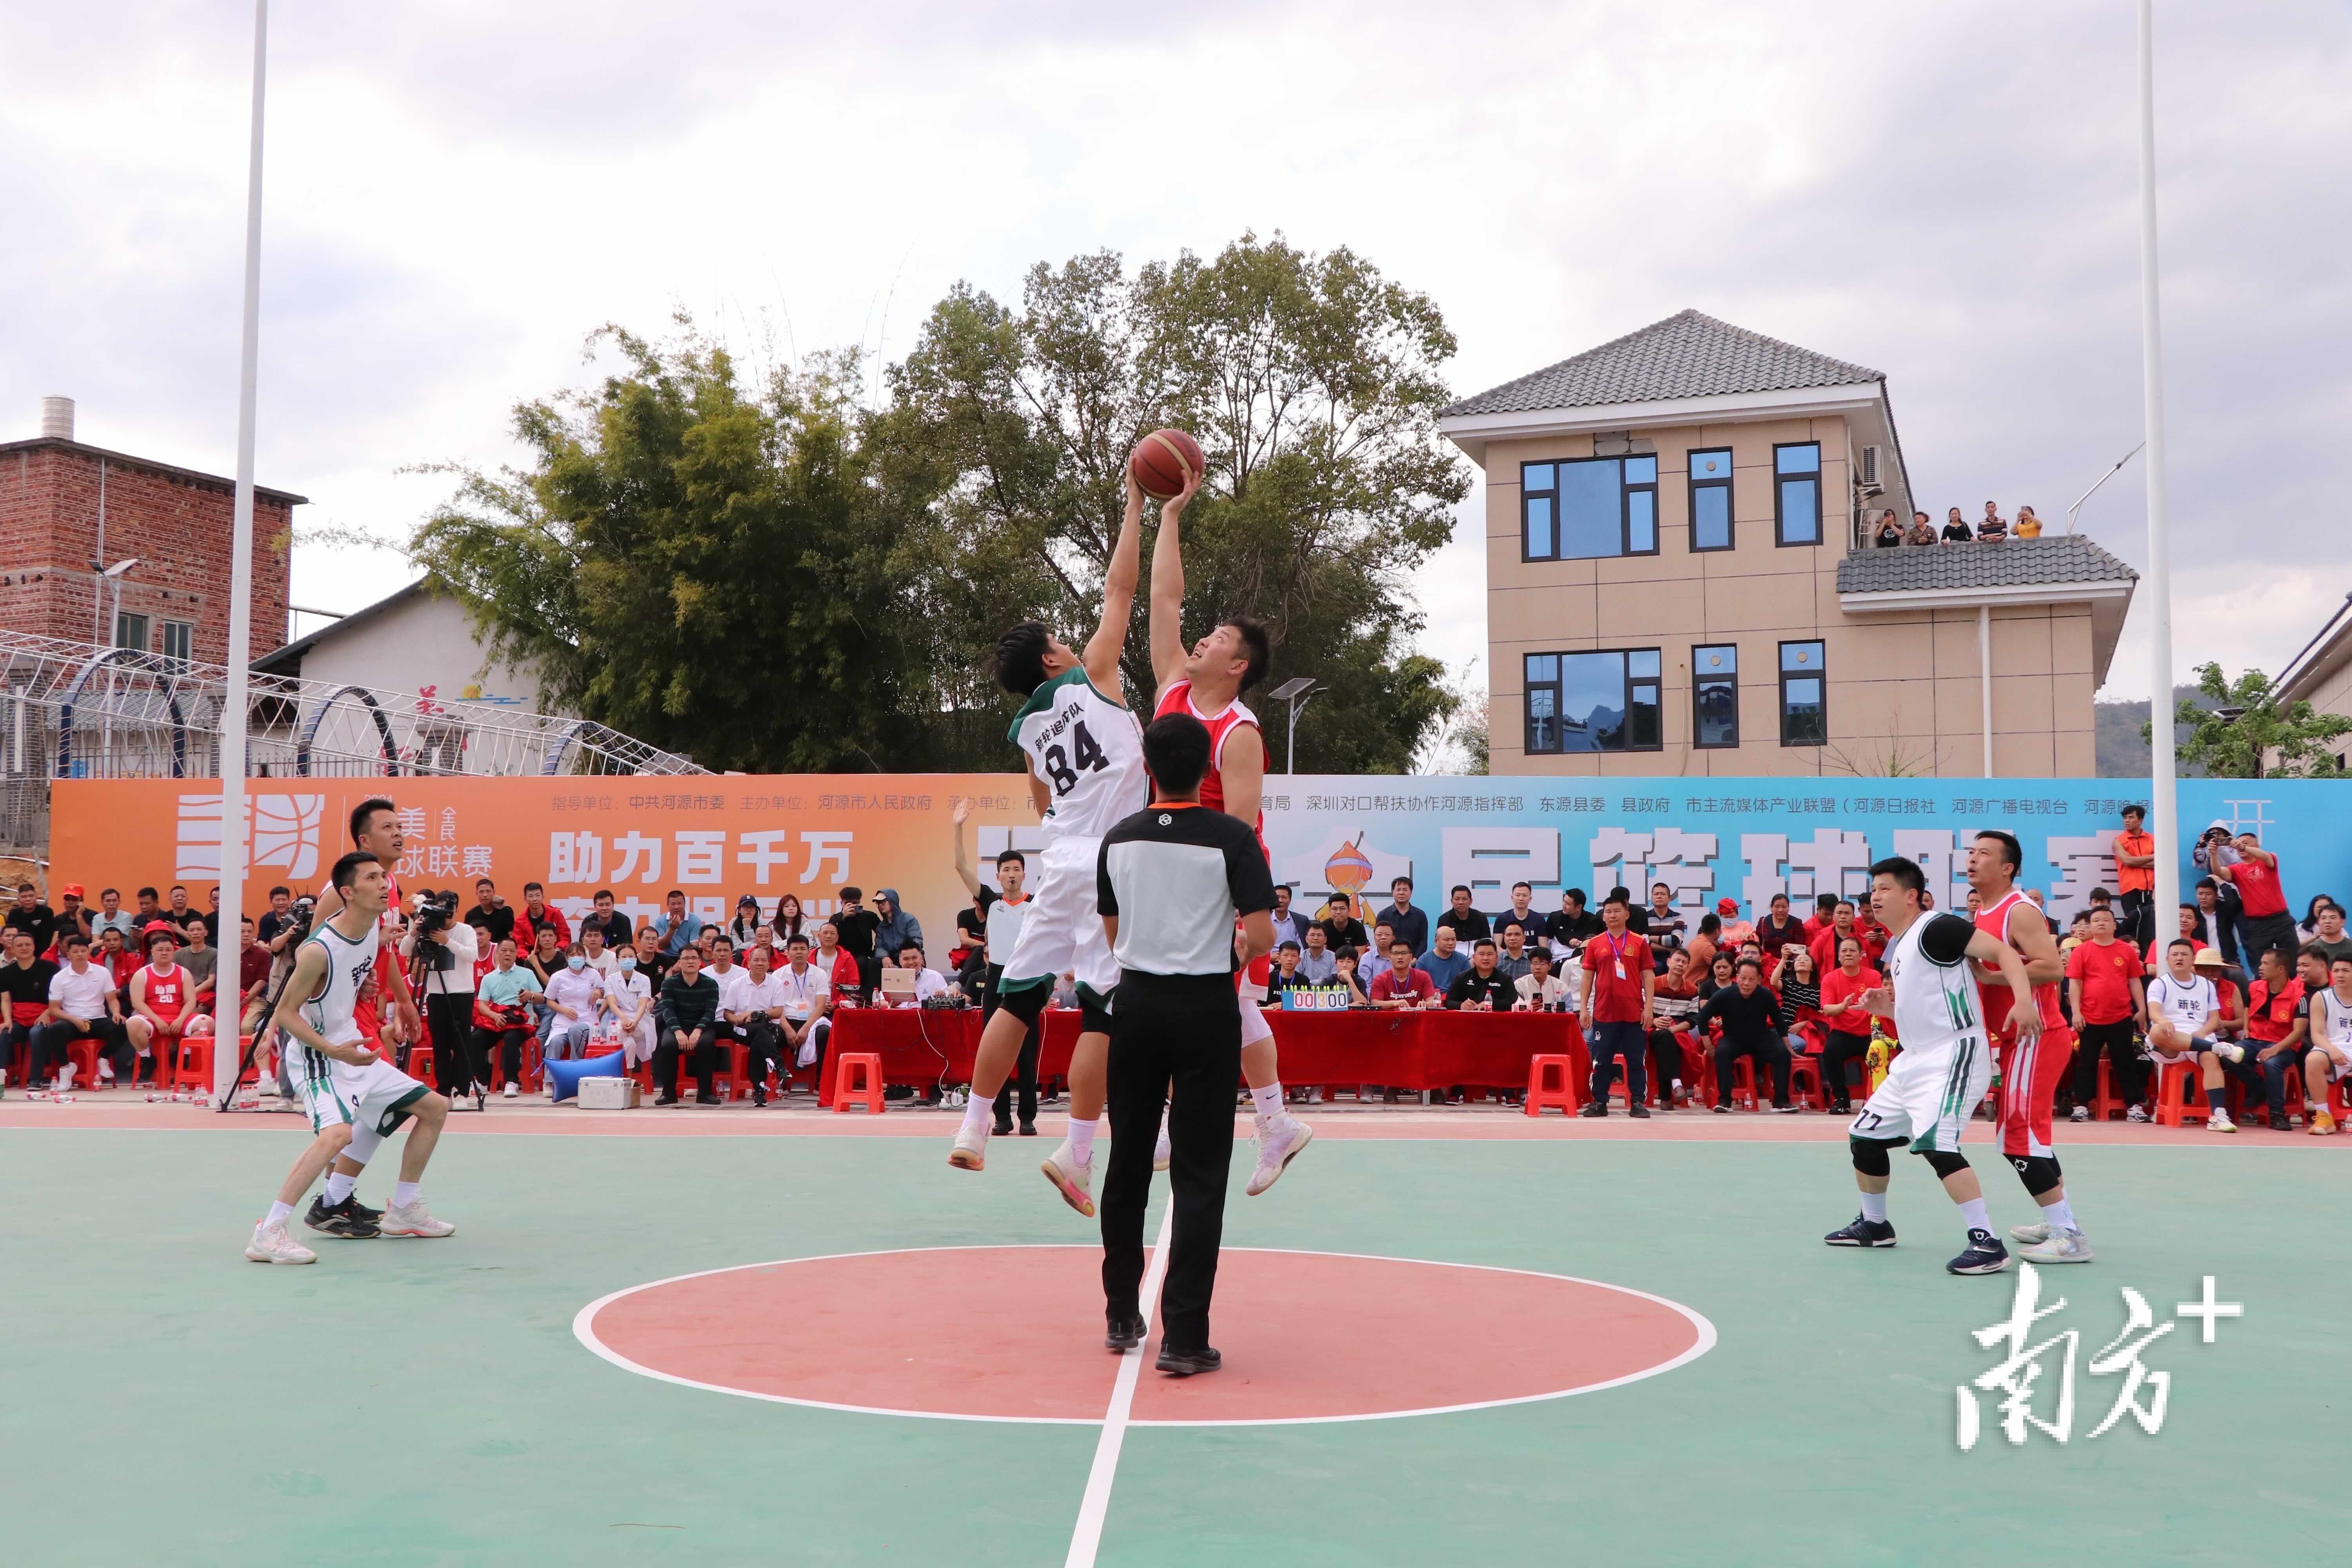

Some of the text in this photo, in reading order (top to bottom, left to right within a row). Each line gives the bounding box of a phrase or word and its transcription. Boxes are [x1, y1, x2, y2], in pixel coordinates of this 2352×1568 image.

[1045, 720, 1110, 797] 84
[630, 795, 724, 810] 中共河源市委
[818, 795, 932, 810] 河源市人民政府
[1307, 795, 1524, 812] 深圳对口帮扶协作河源指挥部
[1539, 796, 1606, 813] 东源县委
[1621, 797, 1671, 813] 县政府
[1952, 799, 2068, 815] 河源广播电视台
[394, 844, 492, 878] 球联赛
[548, 829, 853, 884] 助力百千万
[158, 994, 174, 1003] 20
[2178, 999, 2201, 1011] 新轮
[2339, 1017, 2352, 1028] 新
